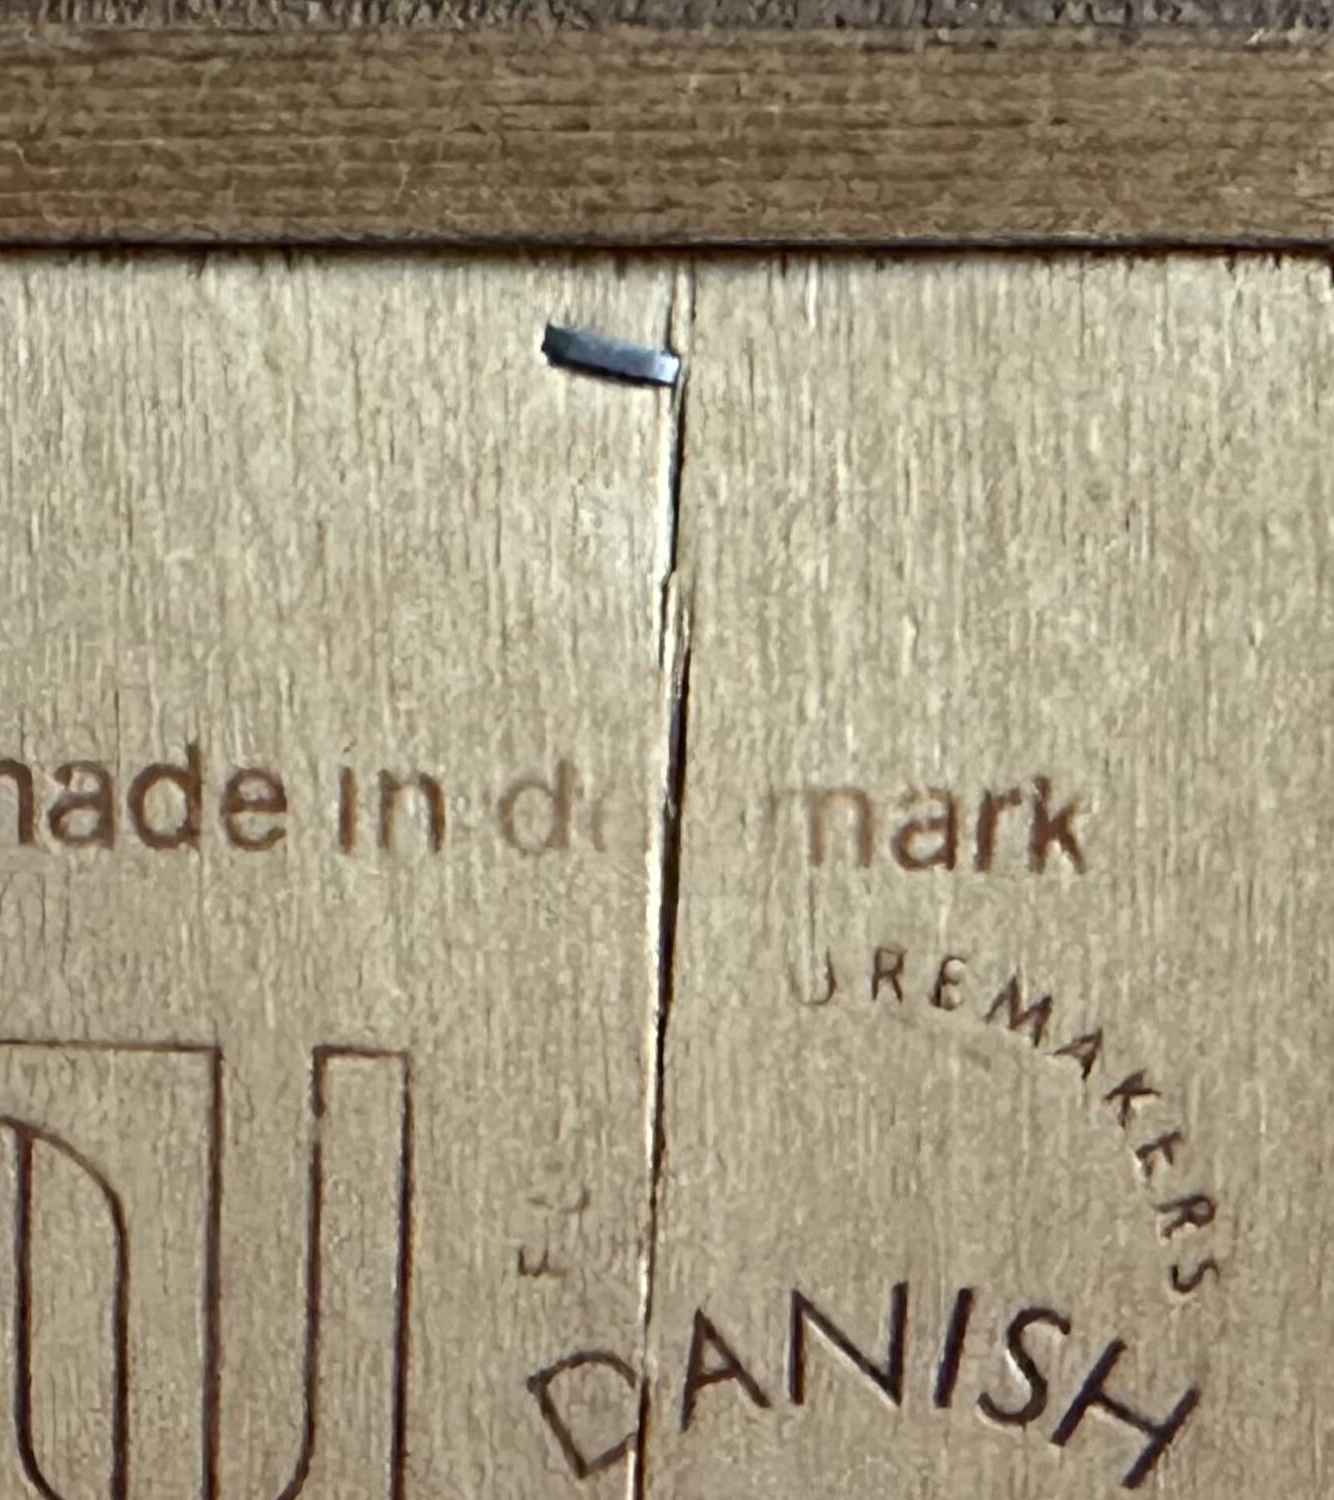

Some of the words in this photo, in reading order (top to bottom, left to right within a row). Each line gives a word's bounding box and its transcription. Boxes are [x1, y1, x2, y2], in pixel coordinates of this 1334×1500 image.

[337, 738, 446, 855] in
[497, 758, 1091, 878] dmark
[527, 1280, 1202, 1491] DANISH
